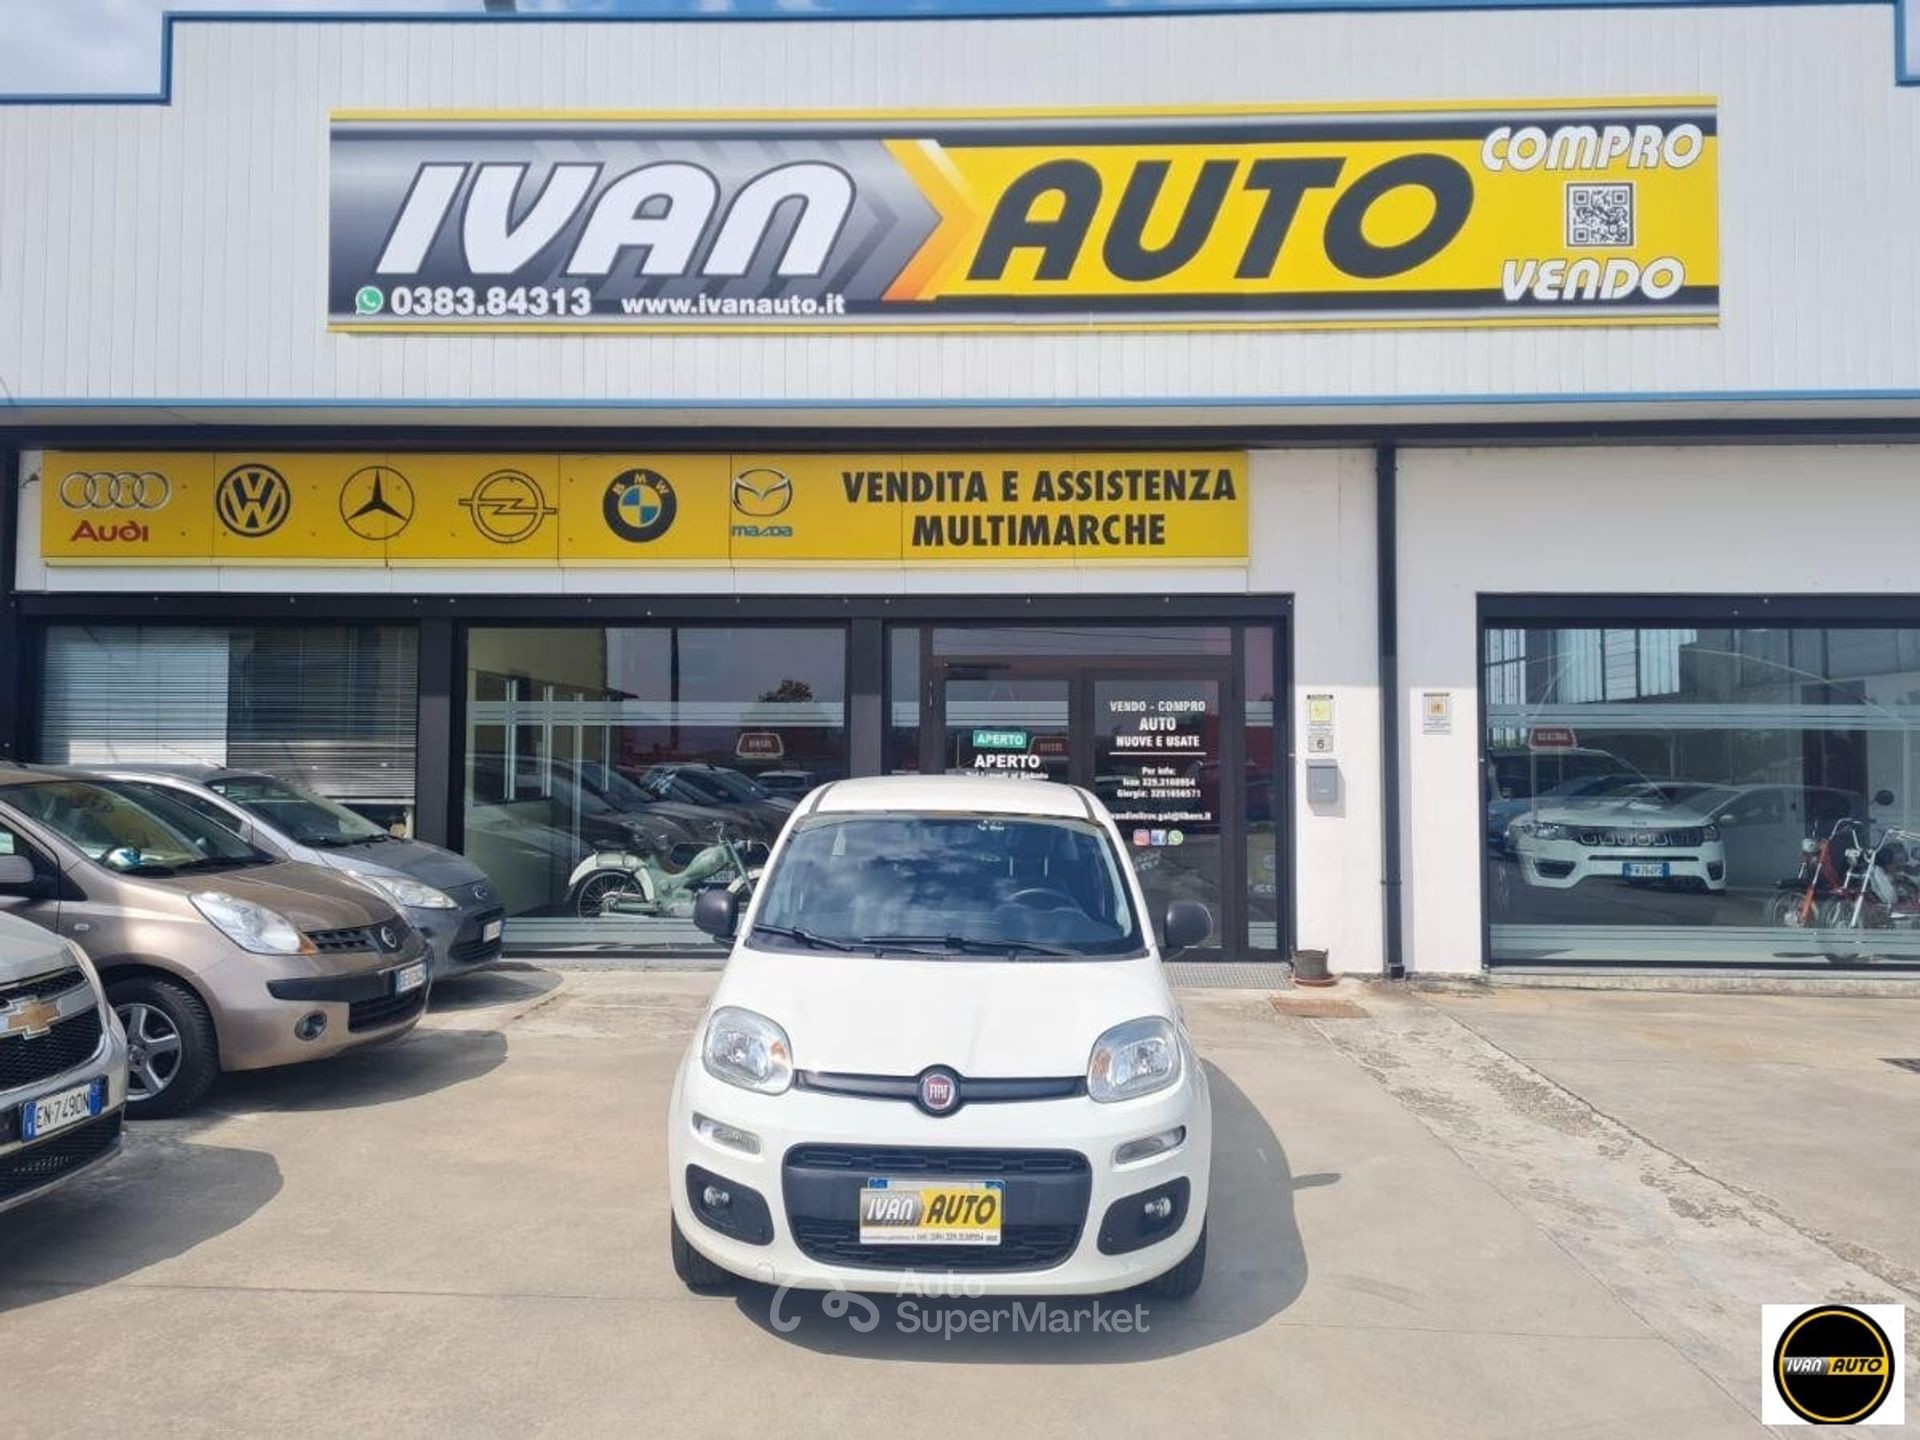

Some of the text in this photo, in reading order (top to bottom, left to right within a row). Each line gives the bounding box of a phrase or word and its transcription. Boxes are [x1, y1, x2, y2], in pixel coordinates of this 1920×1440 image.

[1481, 123, 1703, 173] COMPRO
[374, 152, 1475, 282] IVAN AUTO
[1500, 258, 1685, 302] VENDO
[391, 286, 591, 316] 0383.84313
[621, 292, 845, 315] www.ivanauto.it
[842, 468, 1236, 503] VENDITA E ASSISTENZA
[70, 520, 149, 542] Audi
[912, 513, 1166, 547] MULTIMARCHE
[1110, 701, 1147, 712] VENDO
[1158, 701, 1206, 712] COMPRO
[1139, 717, 1176, 731] AUTO
[977, 734, 1024, 745] APERTO
[1116, 736, 1200, 747] NUOVE E USATE
[1316, 739, 1325, 750] 6
[974, 754, 1041, 768] APERTO
[929, 1084, 949, 1100] FIAT
[867, 1194, 997, 1225] IVAN AUTO
